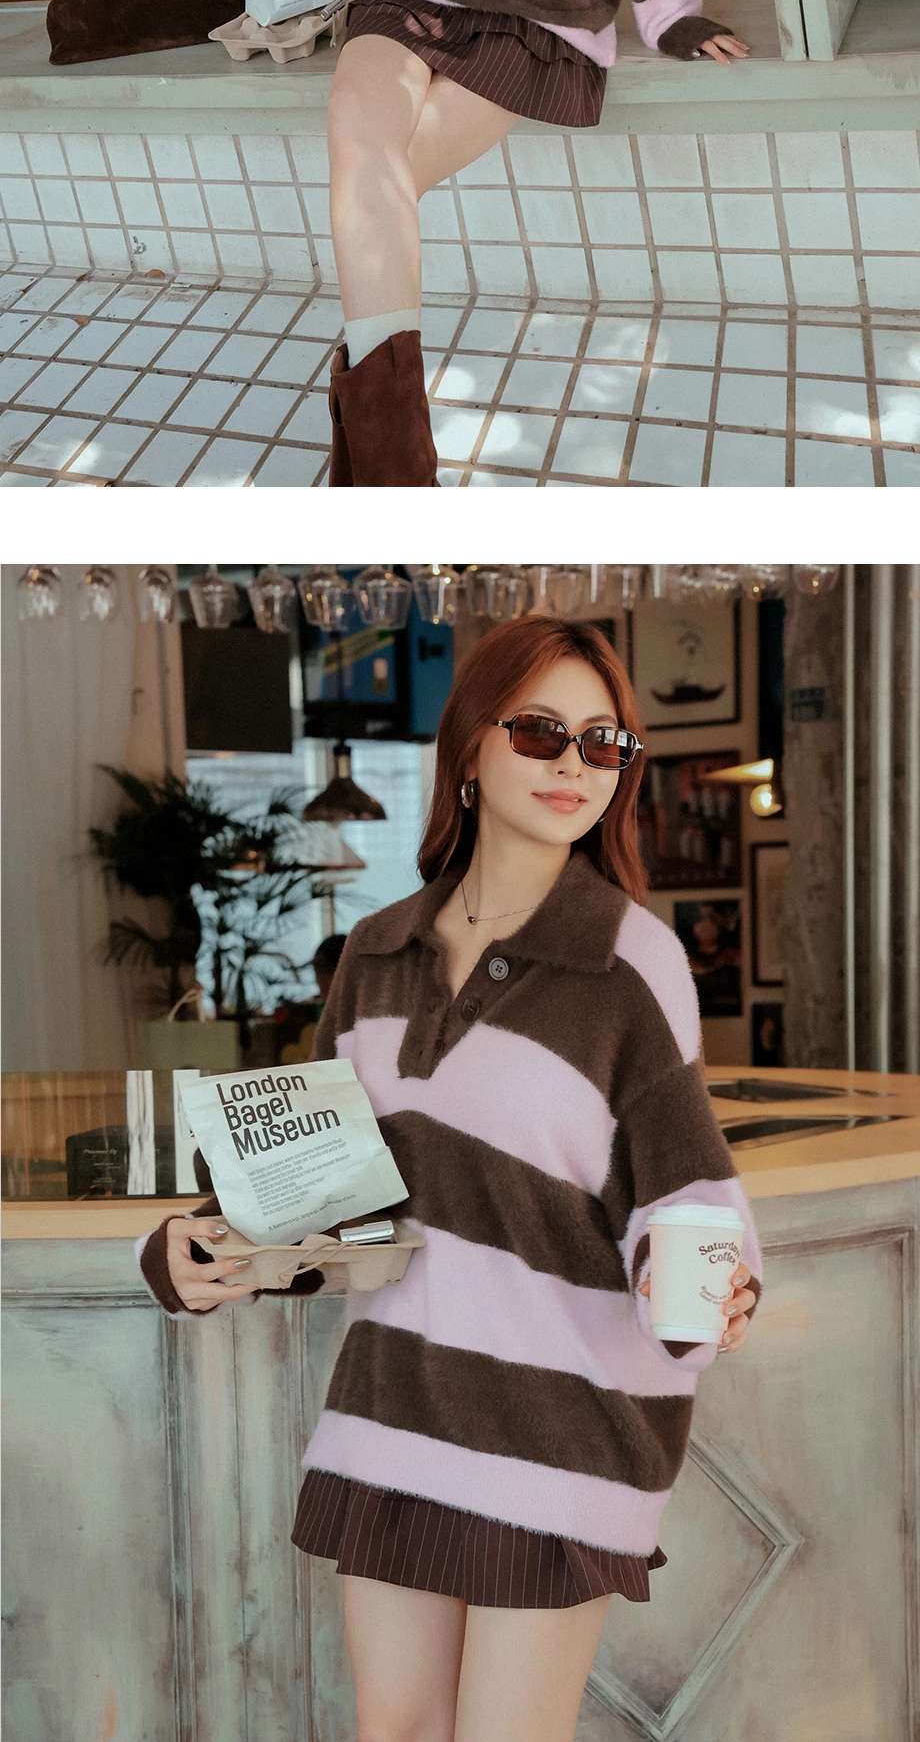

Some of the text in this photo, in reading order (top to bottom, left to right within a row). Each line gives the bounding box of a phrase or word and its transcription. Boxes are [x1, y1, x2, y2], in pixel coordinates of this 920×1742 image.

[216, 1074, 308, 1106] London
[223, 1092, 292, 1131] Bagel
[231, 1108, 340, 1160] Museum
[708, 1252, 736, 1266] Coffee
